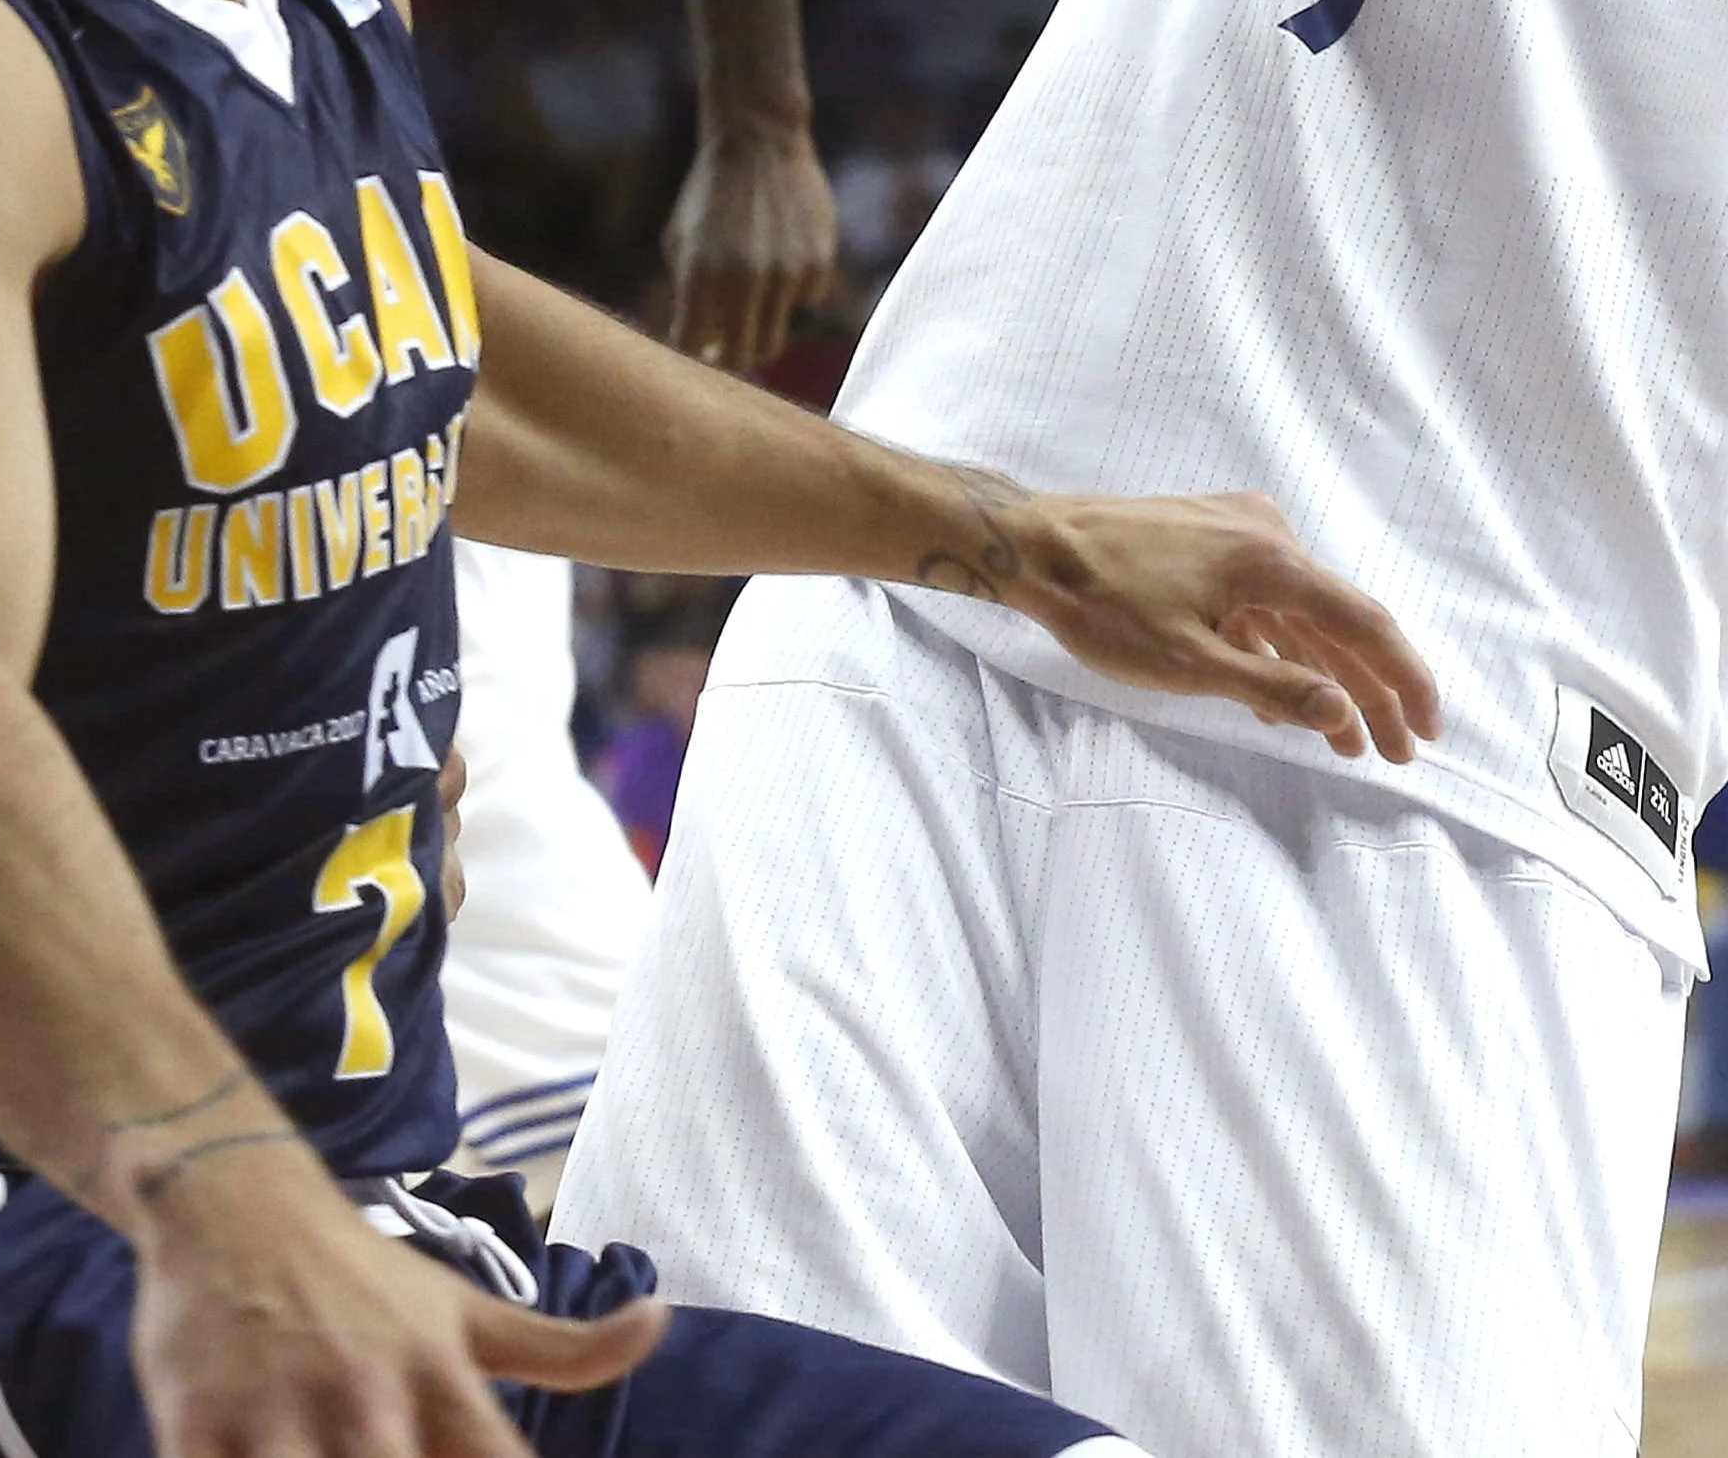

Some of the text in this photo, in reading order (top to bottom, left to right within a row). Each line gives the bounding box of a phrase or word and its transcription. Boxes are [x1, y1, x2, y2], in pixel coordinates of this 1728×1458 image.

[1596, 754, 1635, 796] adidas
[1650, 785, 1672, 826] 2XL
[312, 802, 426, 1081] 7
